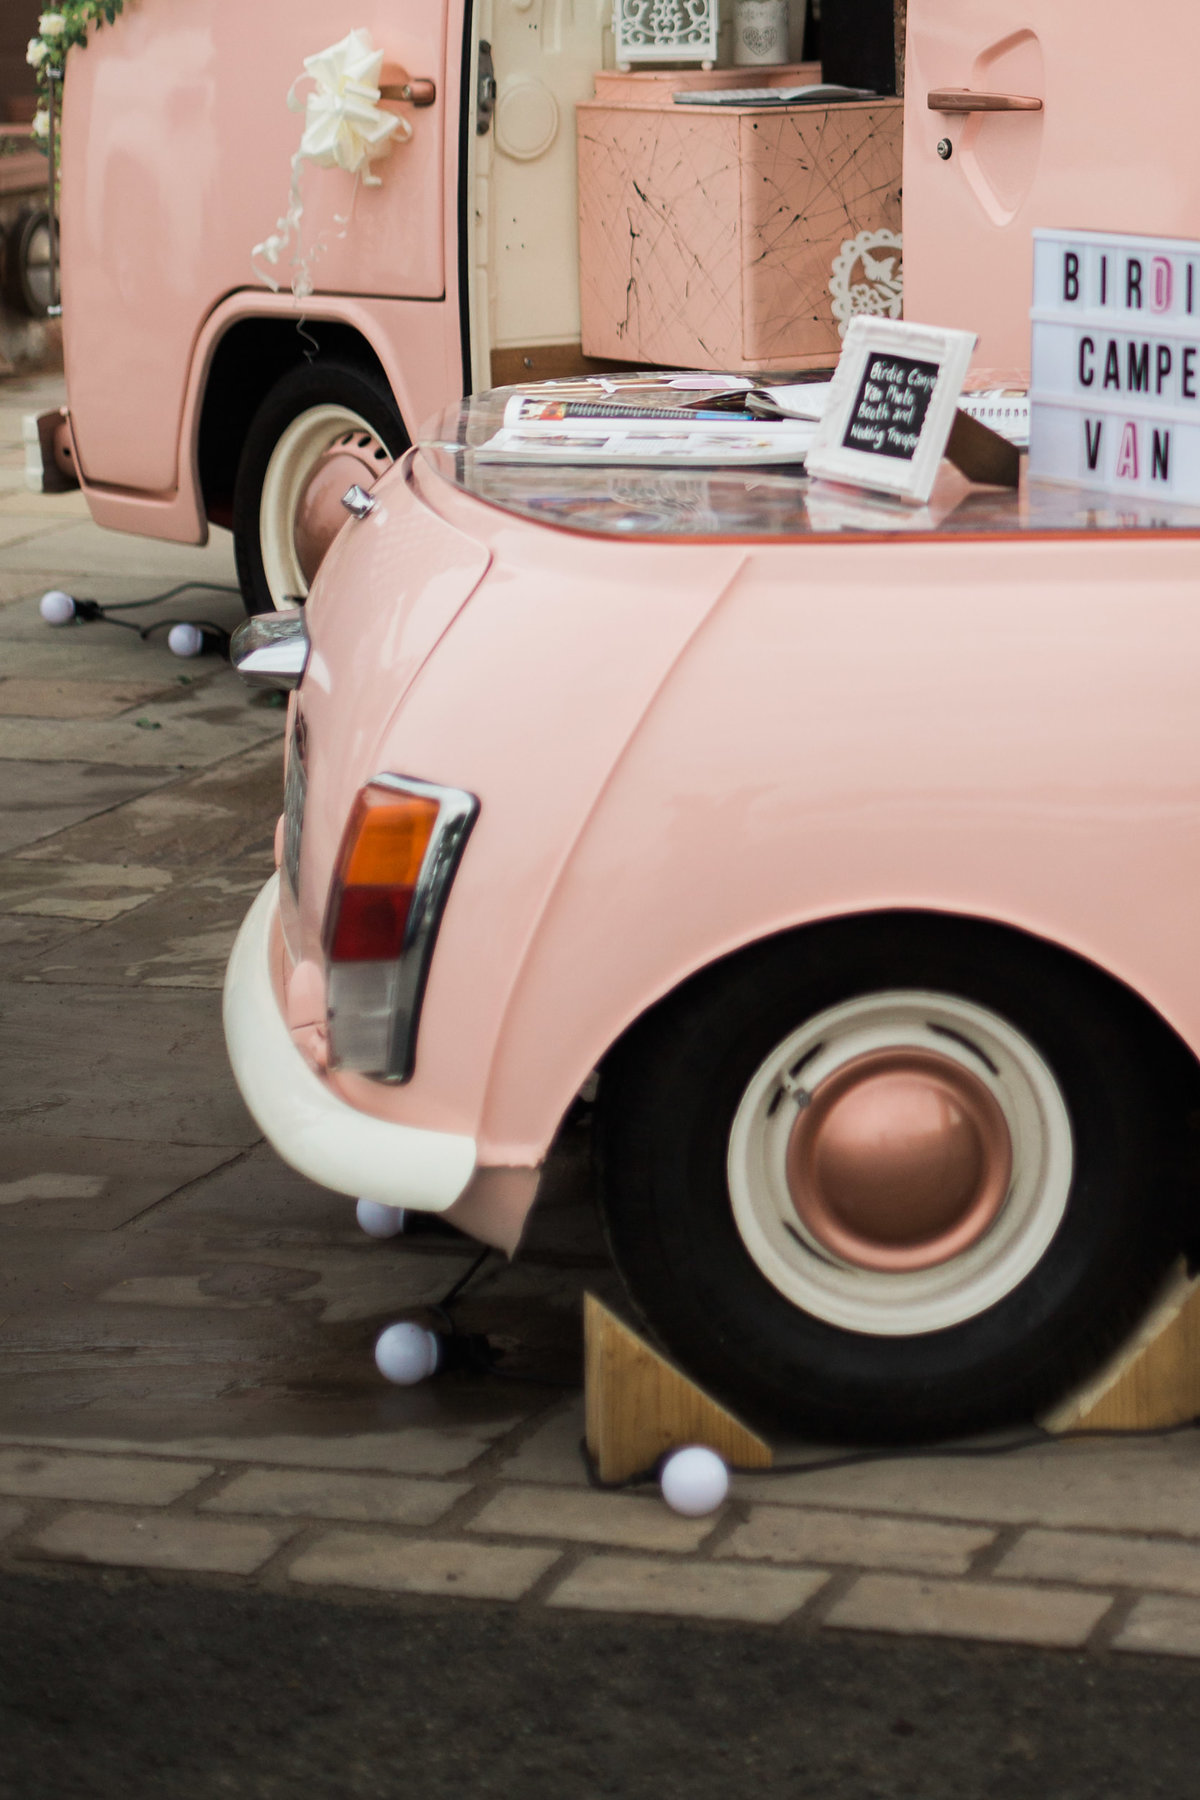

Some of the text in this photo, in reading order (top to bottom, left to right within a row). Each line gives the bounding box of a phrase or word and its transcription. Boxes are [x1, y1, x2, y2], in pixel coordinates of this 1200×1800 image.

[870, 361, 905, 384] Birdie
[864, 381, 915, 406] Van Photo
[858, 401, 916, 425] Booth and
[850, 423, 885, 450] Wedding
[1085, 418, 1170, 481] VAN
